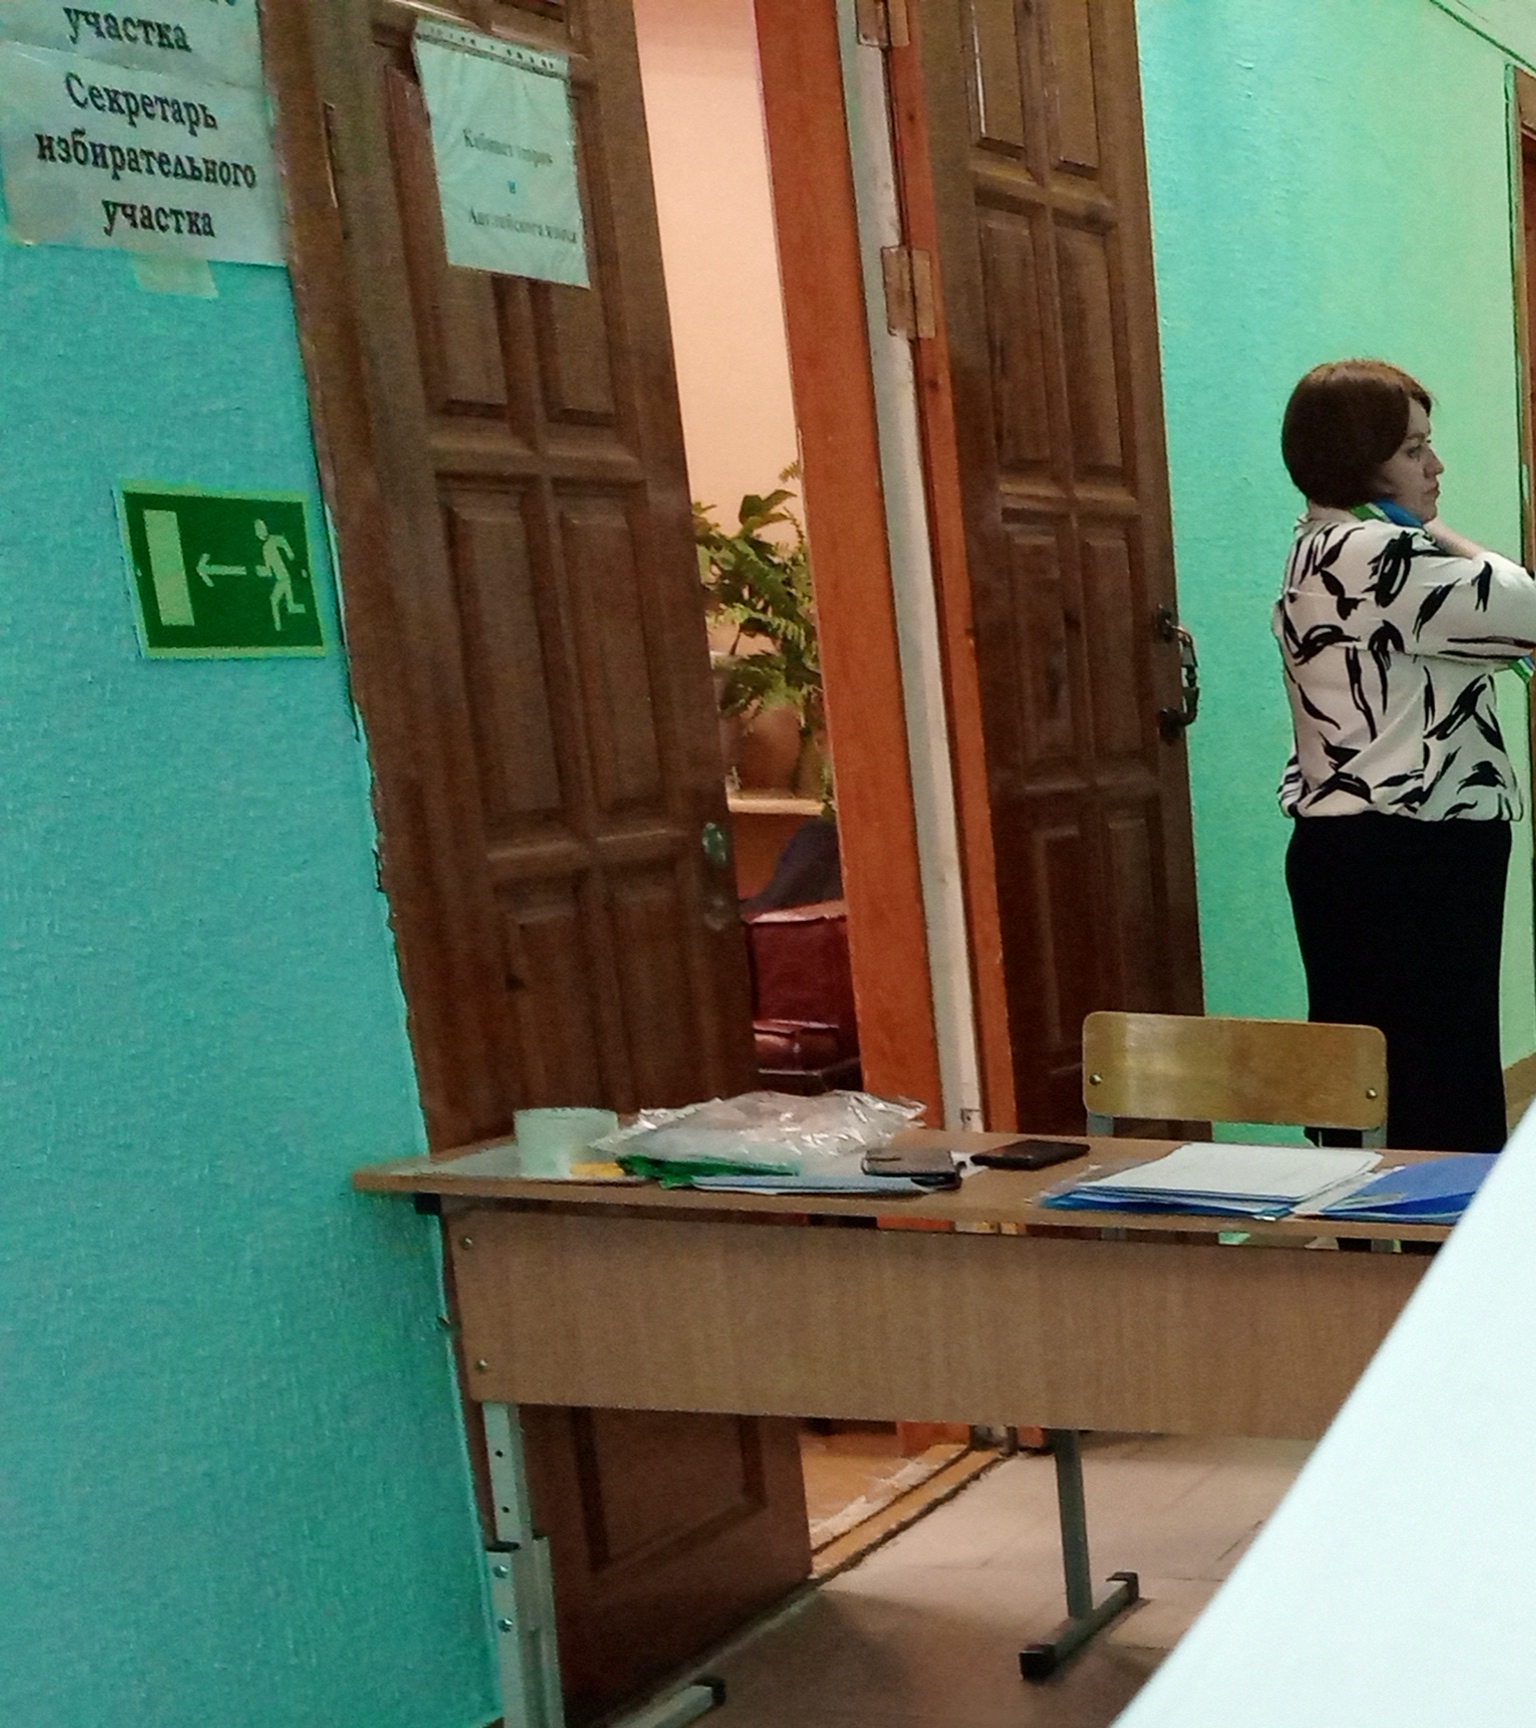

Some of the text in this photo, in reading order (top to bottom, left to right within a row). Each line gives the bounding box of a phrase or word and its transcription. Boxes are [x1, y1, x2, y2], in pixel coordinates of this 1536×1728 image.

[63, 7, 192, 52] участка
[65, 72, 218, 137] Секретарь
[34, 128, 257, 188] избирательного
[101, 199, 216, 238] участка
